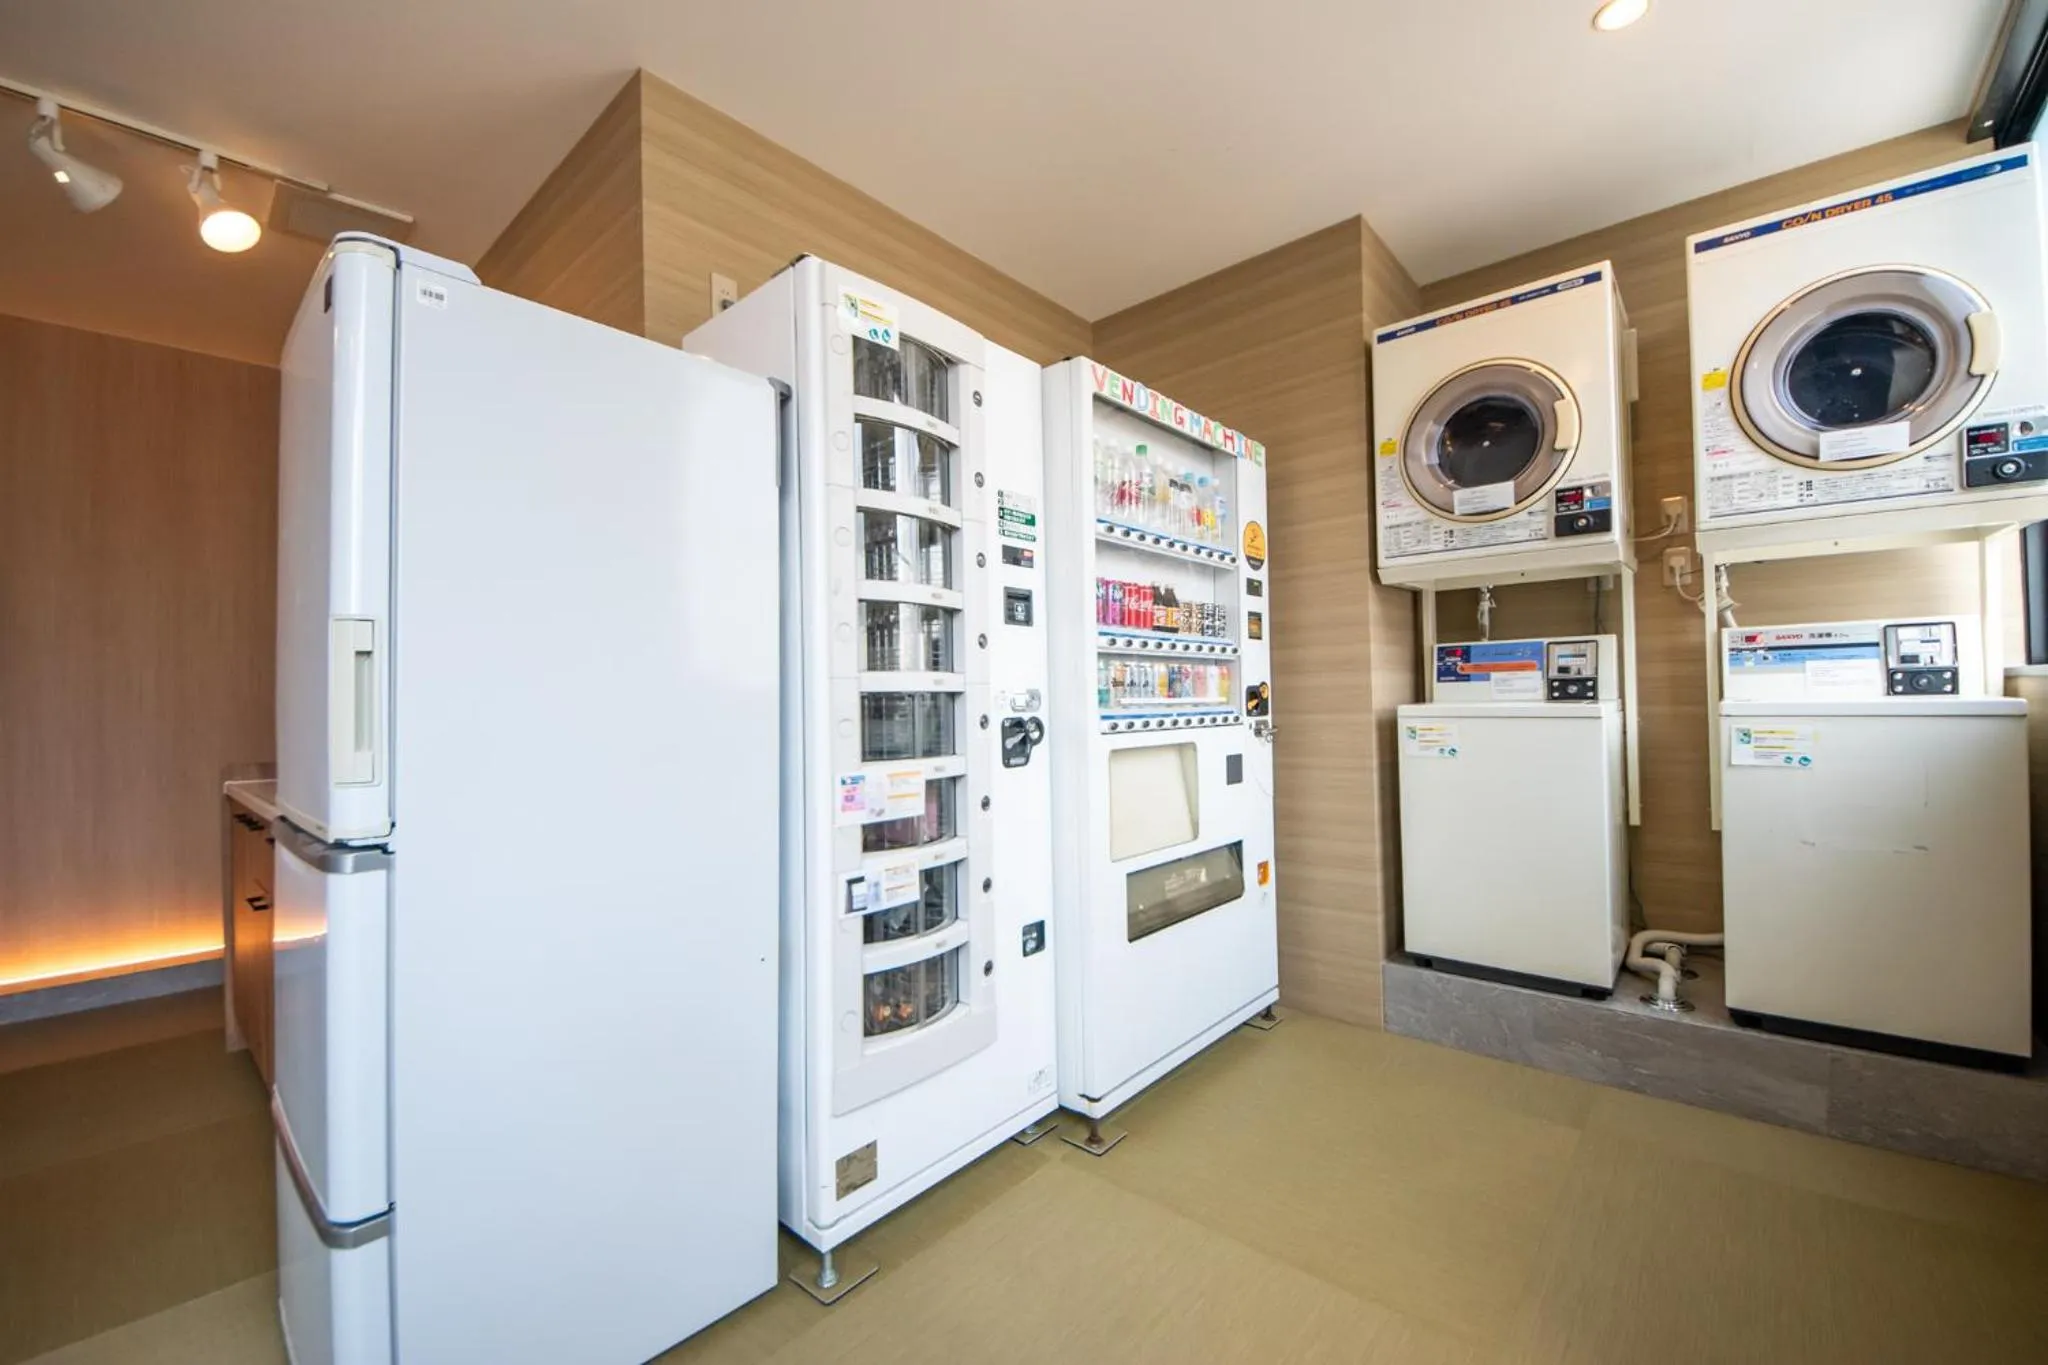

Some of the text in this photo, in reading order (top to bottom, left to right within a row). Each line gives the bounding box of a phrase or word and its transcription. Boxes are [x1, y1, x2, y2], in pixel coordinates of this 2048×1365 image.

[1825, 198, 1871, 218] DRYER
[1875, 193, 1894, 205] 45
[1092, 364, 1264, 467] VENDING MACHINE
[1775, 633, 1803, 641] SANYO
